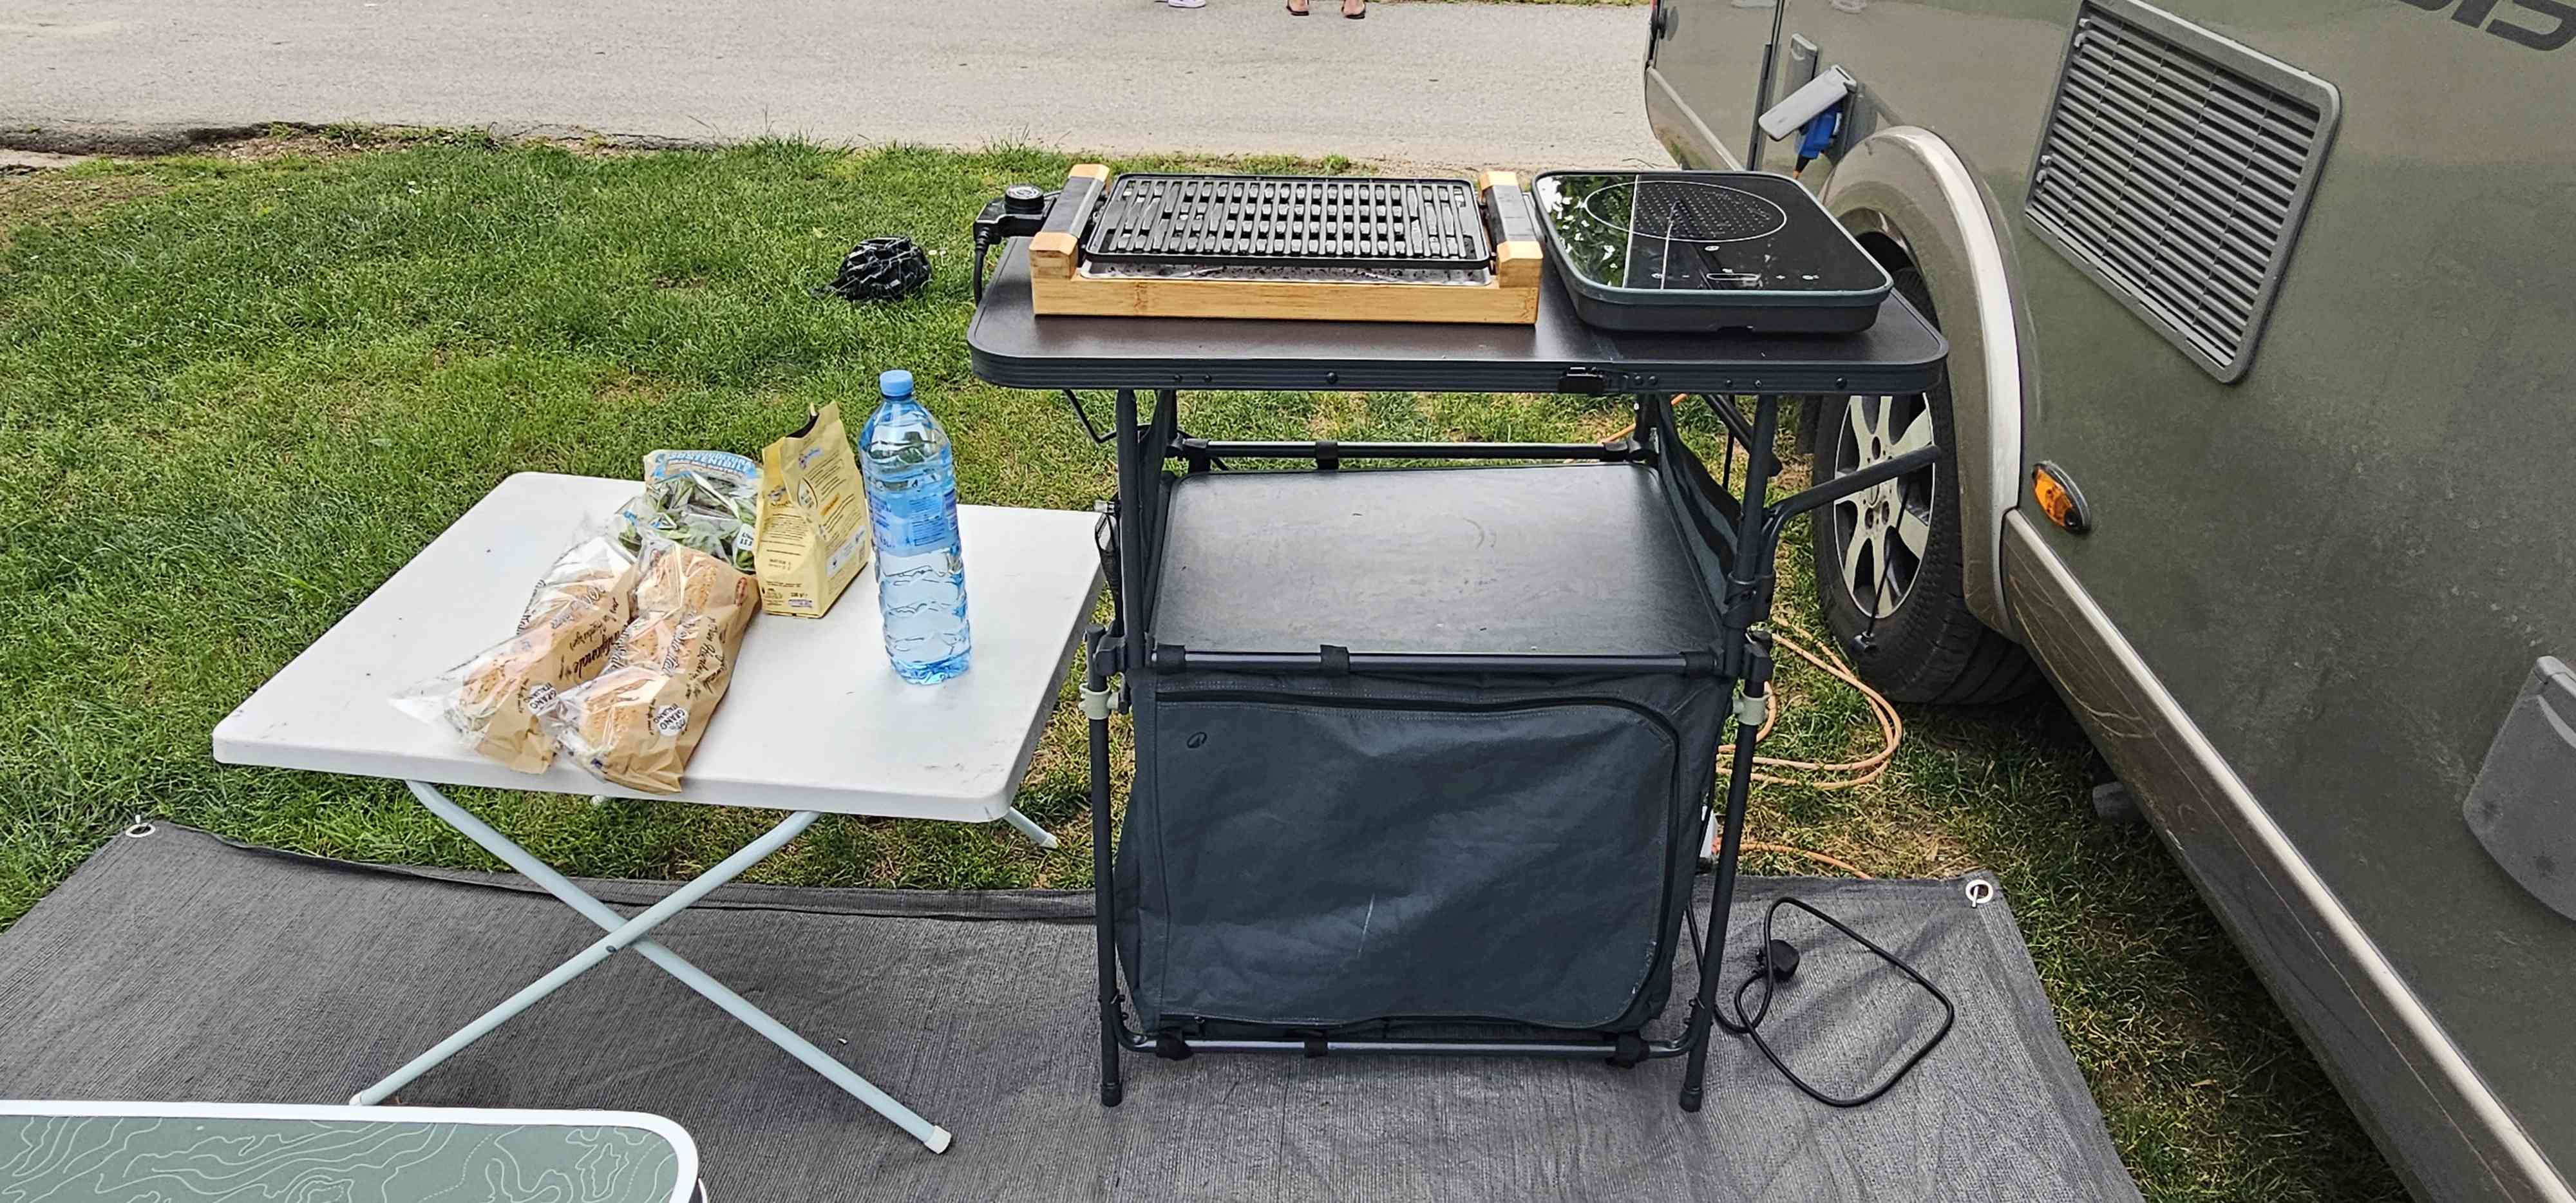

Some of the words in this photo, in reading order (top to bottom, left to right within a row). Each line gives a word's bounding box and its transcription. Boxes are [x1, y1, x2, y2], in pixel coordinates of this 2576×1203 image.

[529, 689, 557, 709] GRANO
[653, 703, 679, 724] ITALIANO
[659, 709, 685, 730] GRANO
